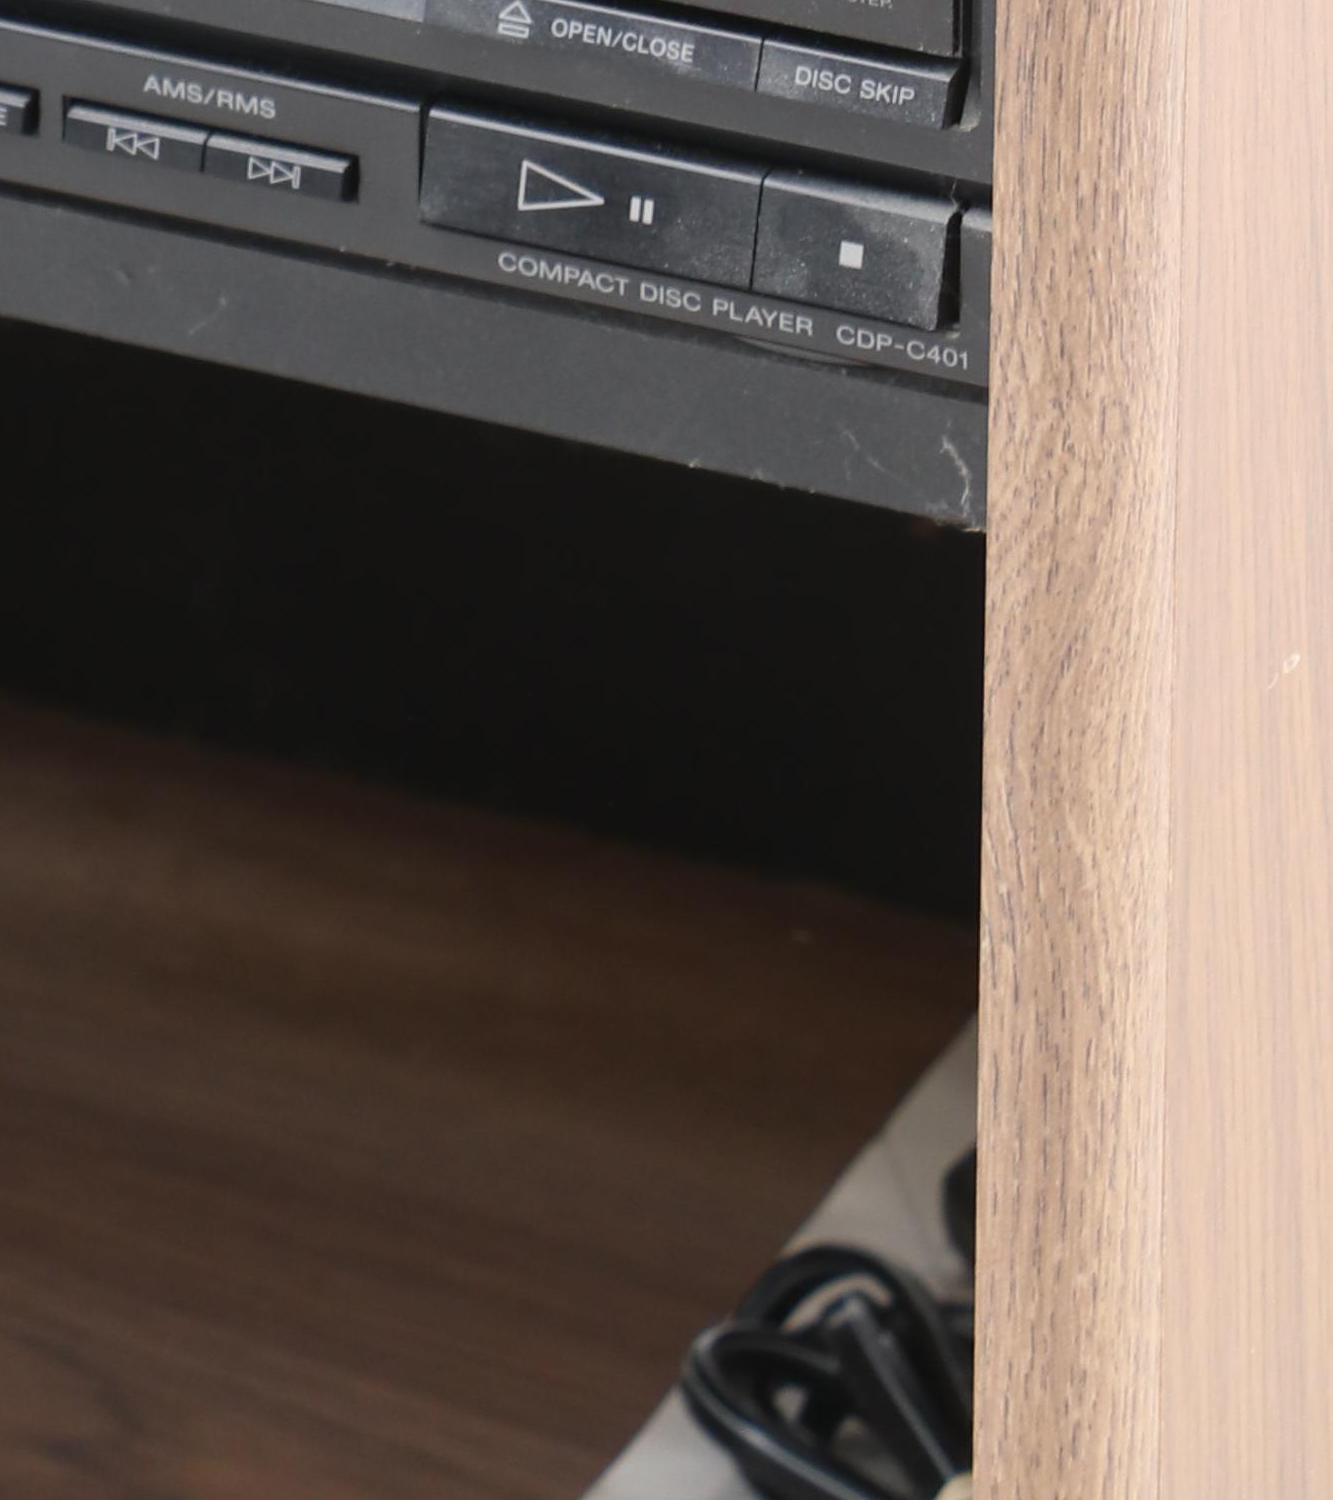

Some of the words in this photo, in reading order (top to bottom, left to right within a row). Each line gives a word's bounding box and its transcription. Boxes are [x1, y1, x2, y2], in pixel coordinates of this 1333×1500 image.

[551, 17, 695, 64] OPEN/CLOSE
[143, 74, 277, 120] AMS/RMS
[795, 66, 851, 95] DISC
[859, 81, 915, 107] SKIP
[497, 251, 629, 298] COMPACT
[639, 280, 702, 314] DISC
[712, 298, 813, 337] PLAYER
[836, 324, 970, 372] CDP-C401
